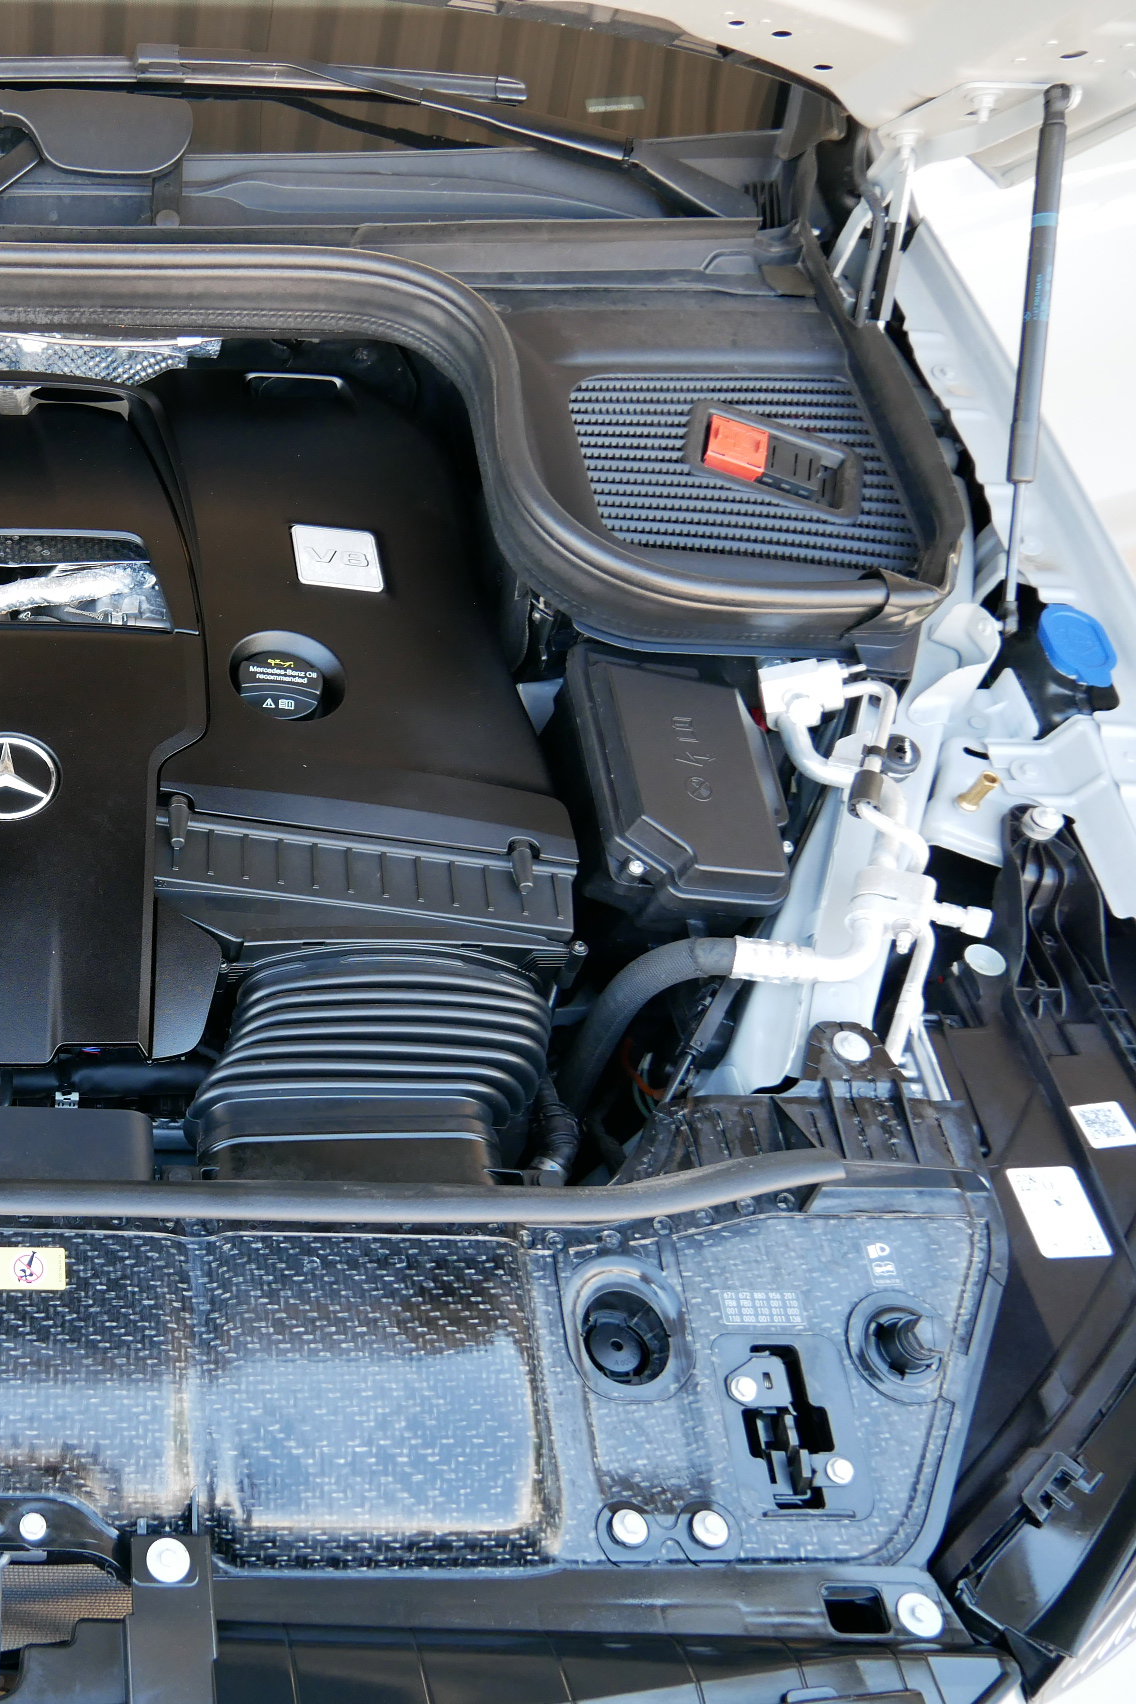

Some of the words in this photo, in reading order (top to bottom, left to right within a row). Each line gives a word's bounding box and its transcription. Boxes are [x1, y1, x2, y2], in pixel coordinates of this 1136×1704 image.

[303, 546, 370, 568] V8
[250, 666, 305, 677] Mercedes-Benz
[256, 673, 307, 684] recommended
